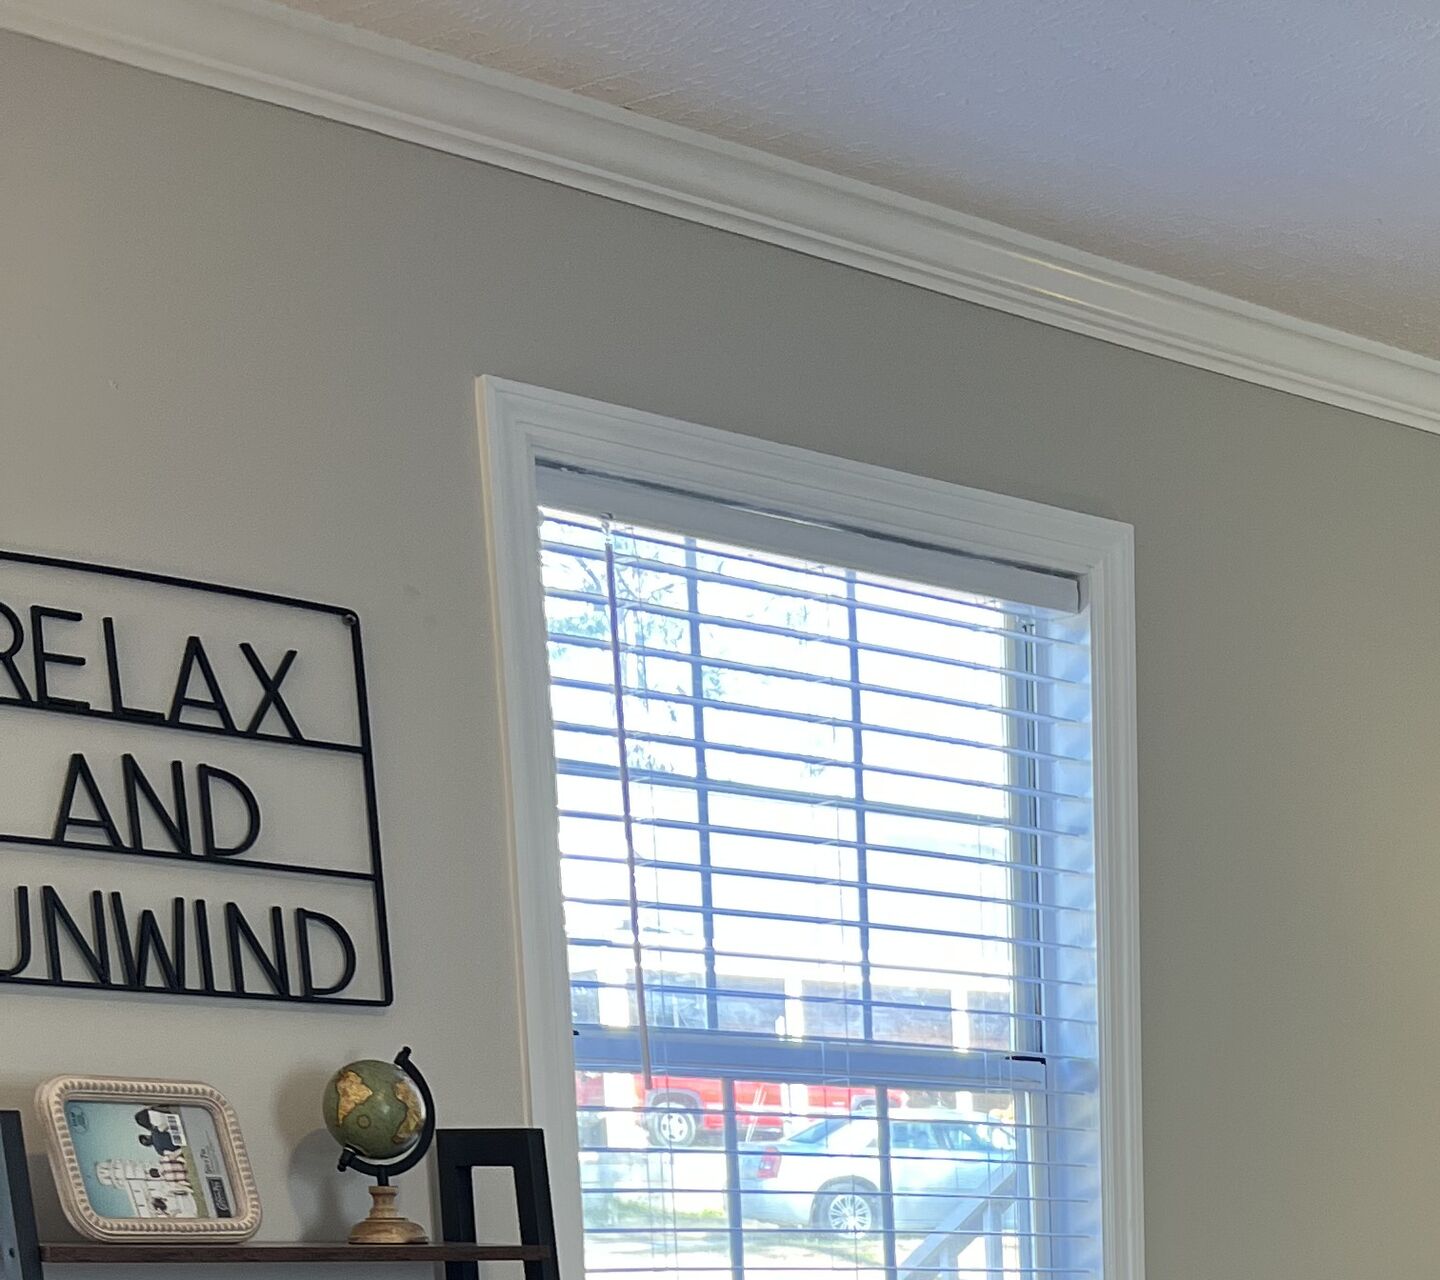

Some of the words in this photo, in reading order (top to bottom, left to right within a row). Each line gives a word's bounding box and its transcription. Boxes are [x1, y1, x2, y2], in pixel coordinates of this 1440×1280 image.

[0, 602, 305, 740] RELAX
[52, 753, 261, 858] AND
[0, 885, 357, 998] UNWIND
